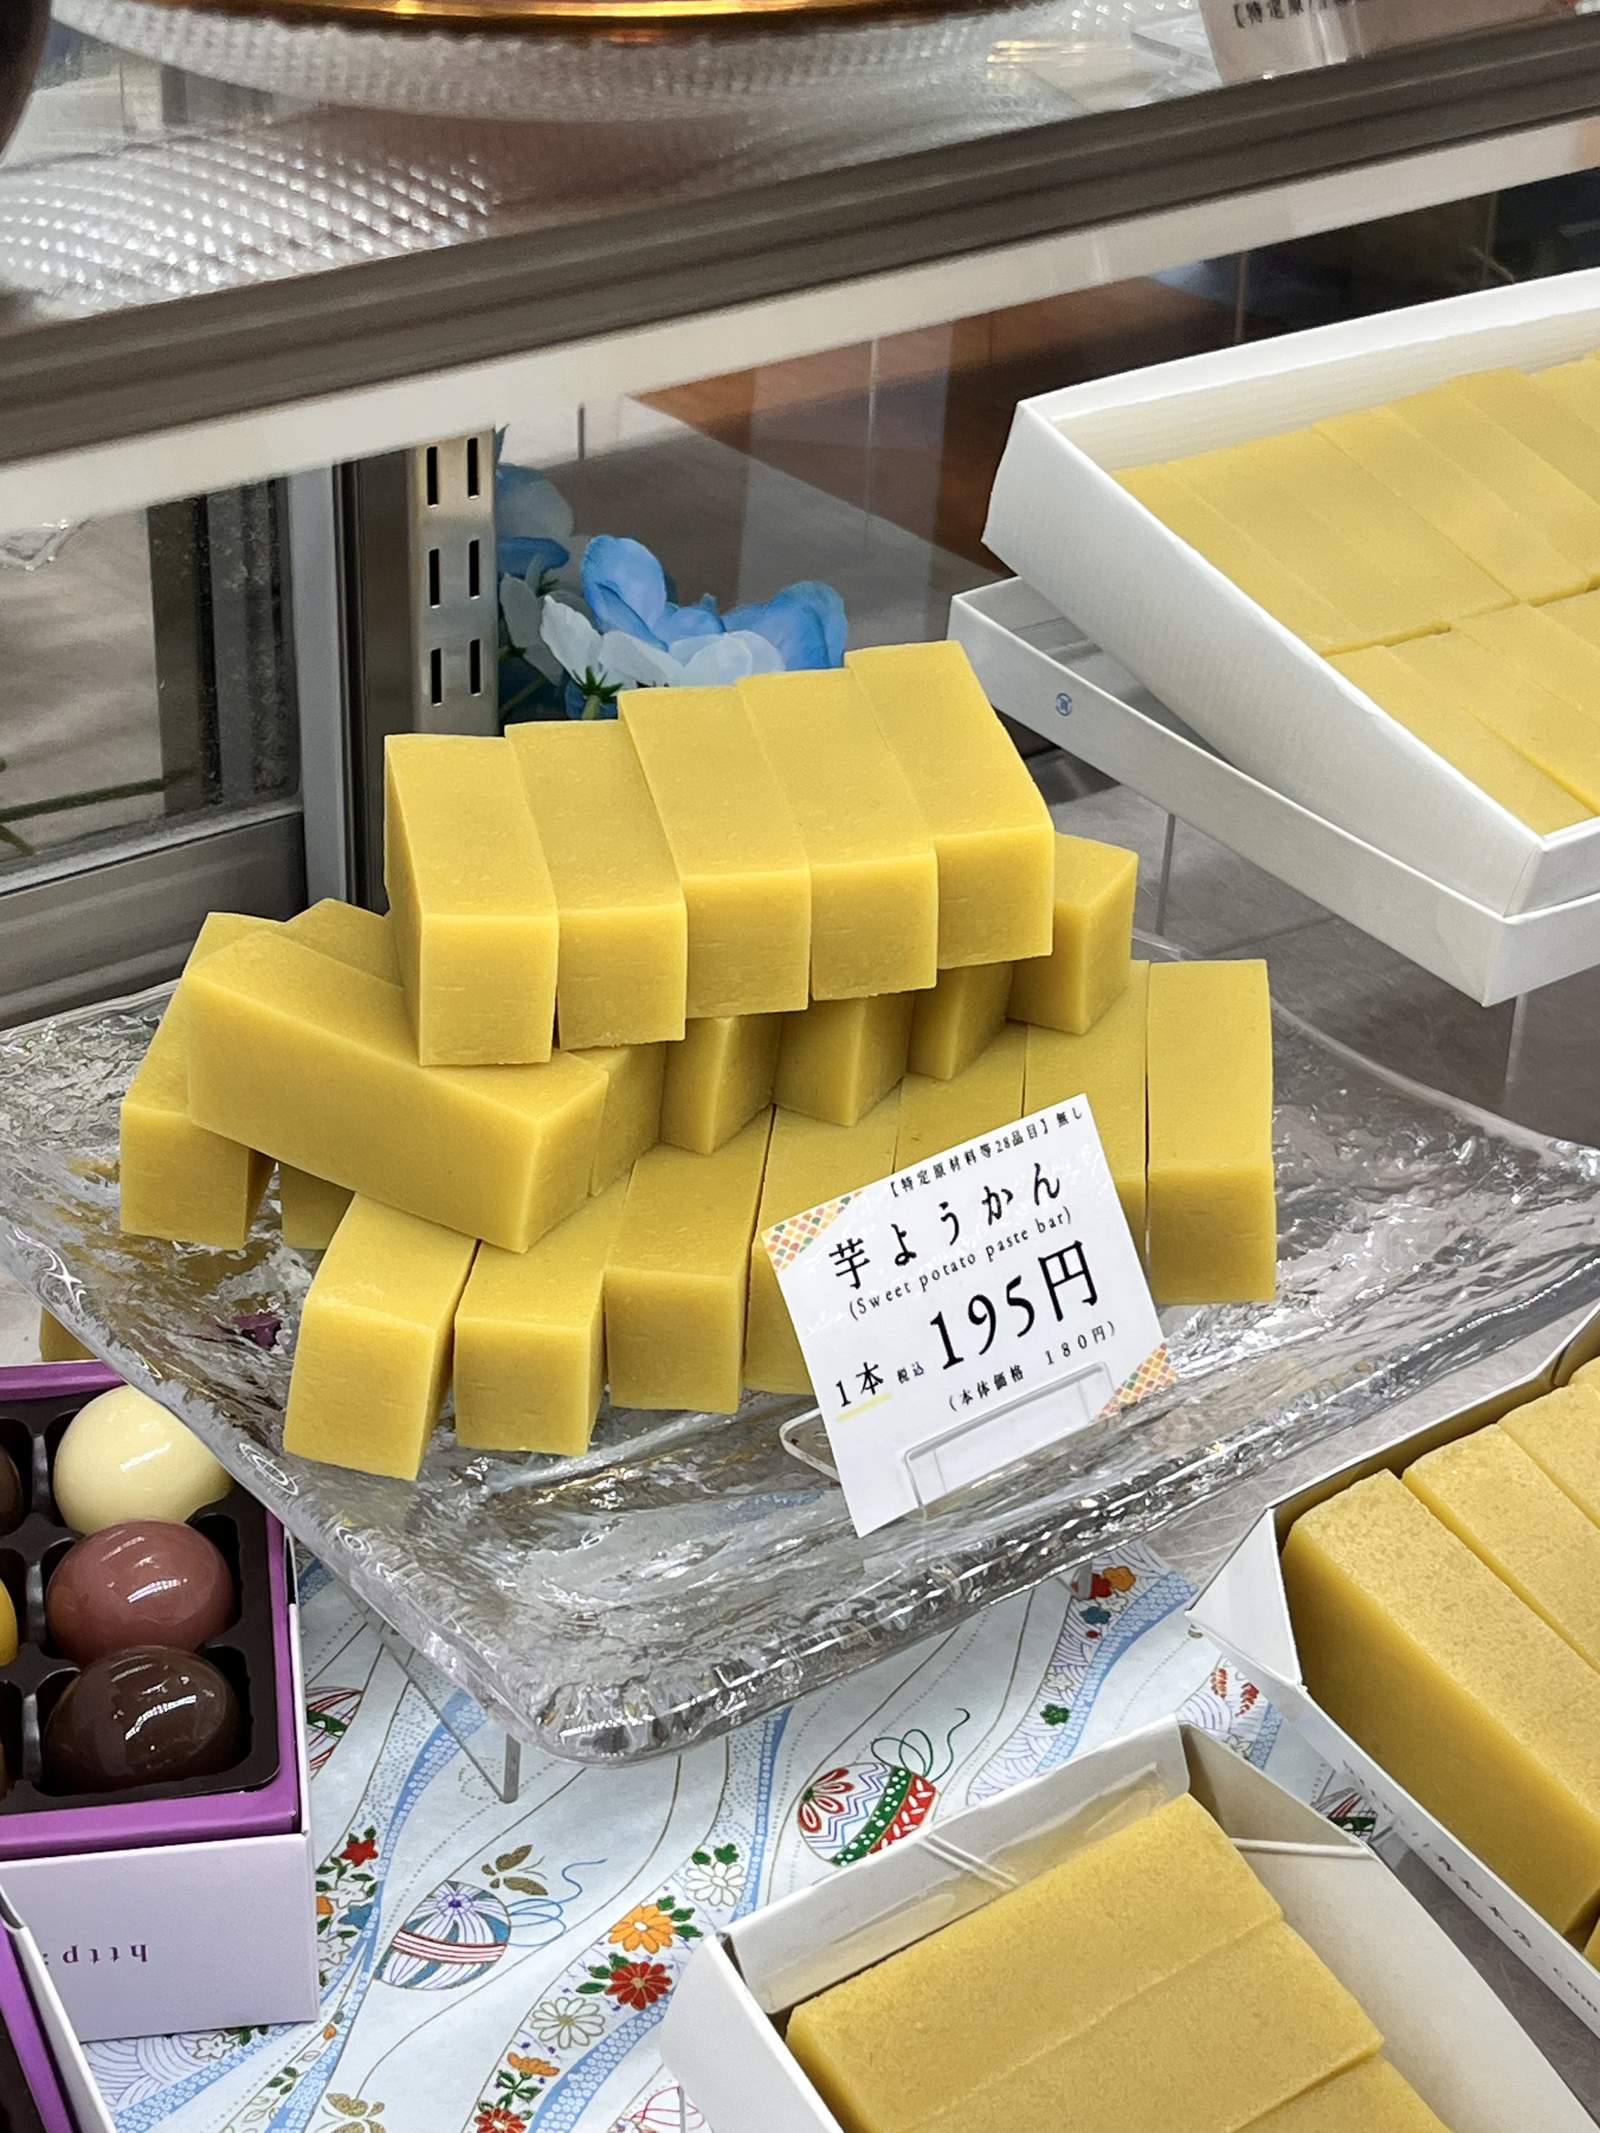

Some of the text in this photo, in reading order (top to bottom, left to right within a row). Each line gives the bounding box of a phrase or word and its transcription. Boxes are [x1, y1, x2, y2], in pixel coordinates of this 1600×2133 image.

[828, 1162, 1060, 1290] 芋ようかん
[849, 1206, 1071, 1320] (Sweet potato paste bar)
[835, 1362, 884, 1407] 1本
[929, 1240, 1099, 1370] 195円
